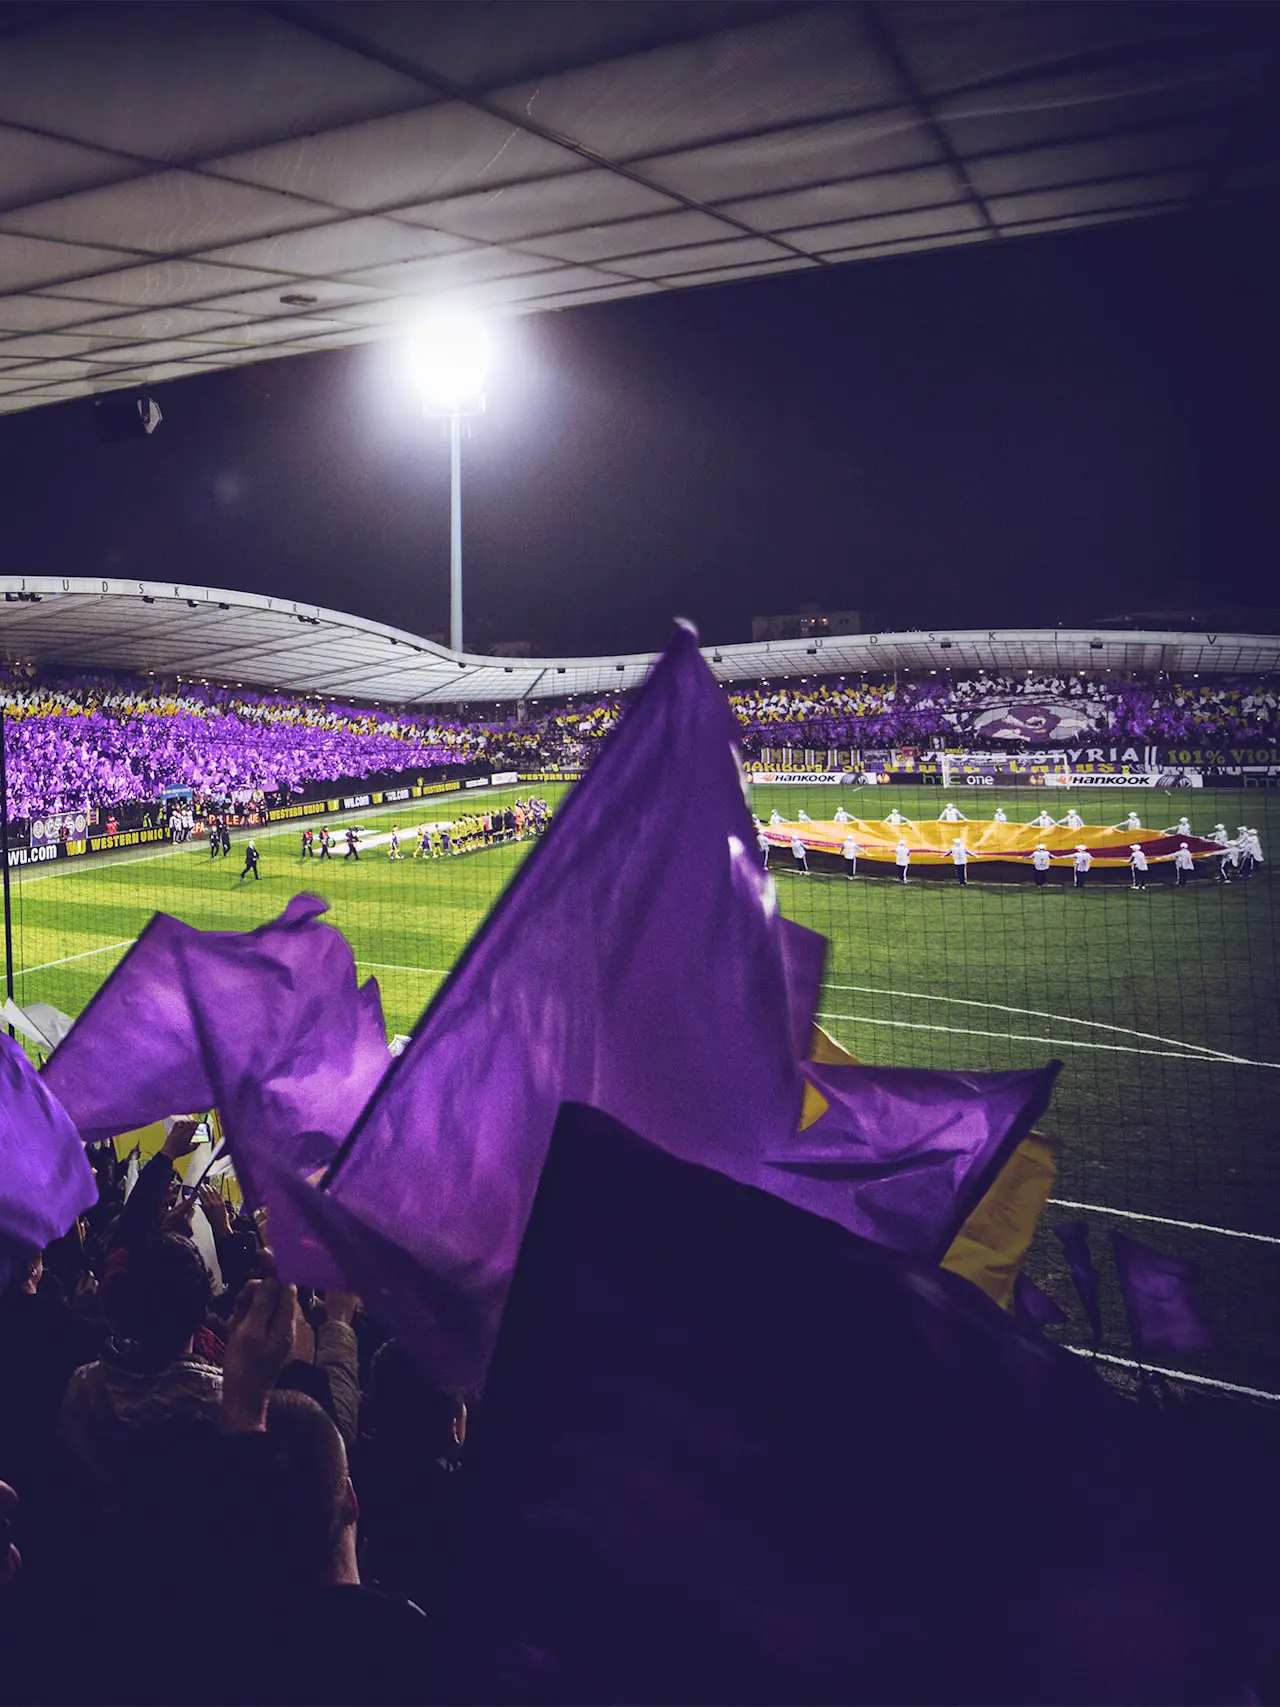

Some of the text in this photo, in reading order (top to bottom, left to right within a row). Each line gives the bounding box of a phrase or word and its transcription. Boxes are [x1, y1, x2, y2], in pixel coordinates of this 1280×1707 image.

[1034, 747, 1139, 764] STYRIA
[1168, 750, 1225, 764] 101%
[966, 775, 994, 785] one
[269, 805, 303, 821] WESTERN
[91, 829, 140, 851] WESTERN
